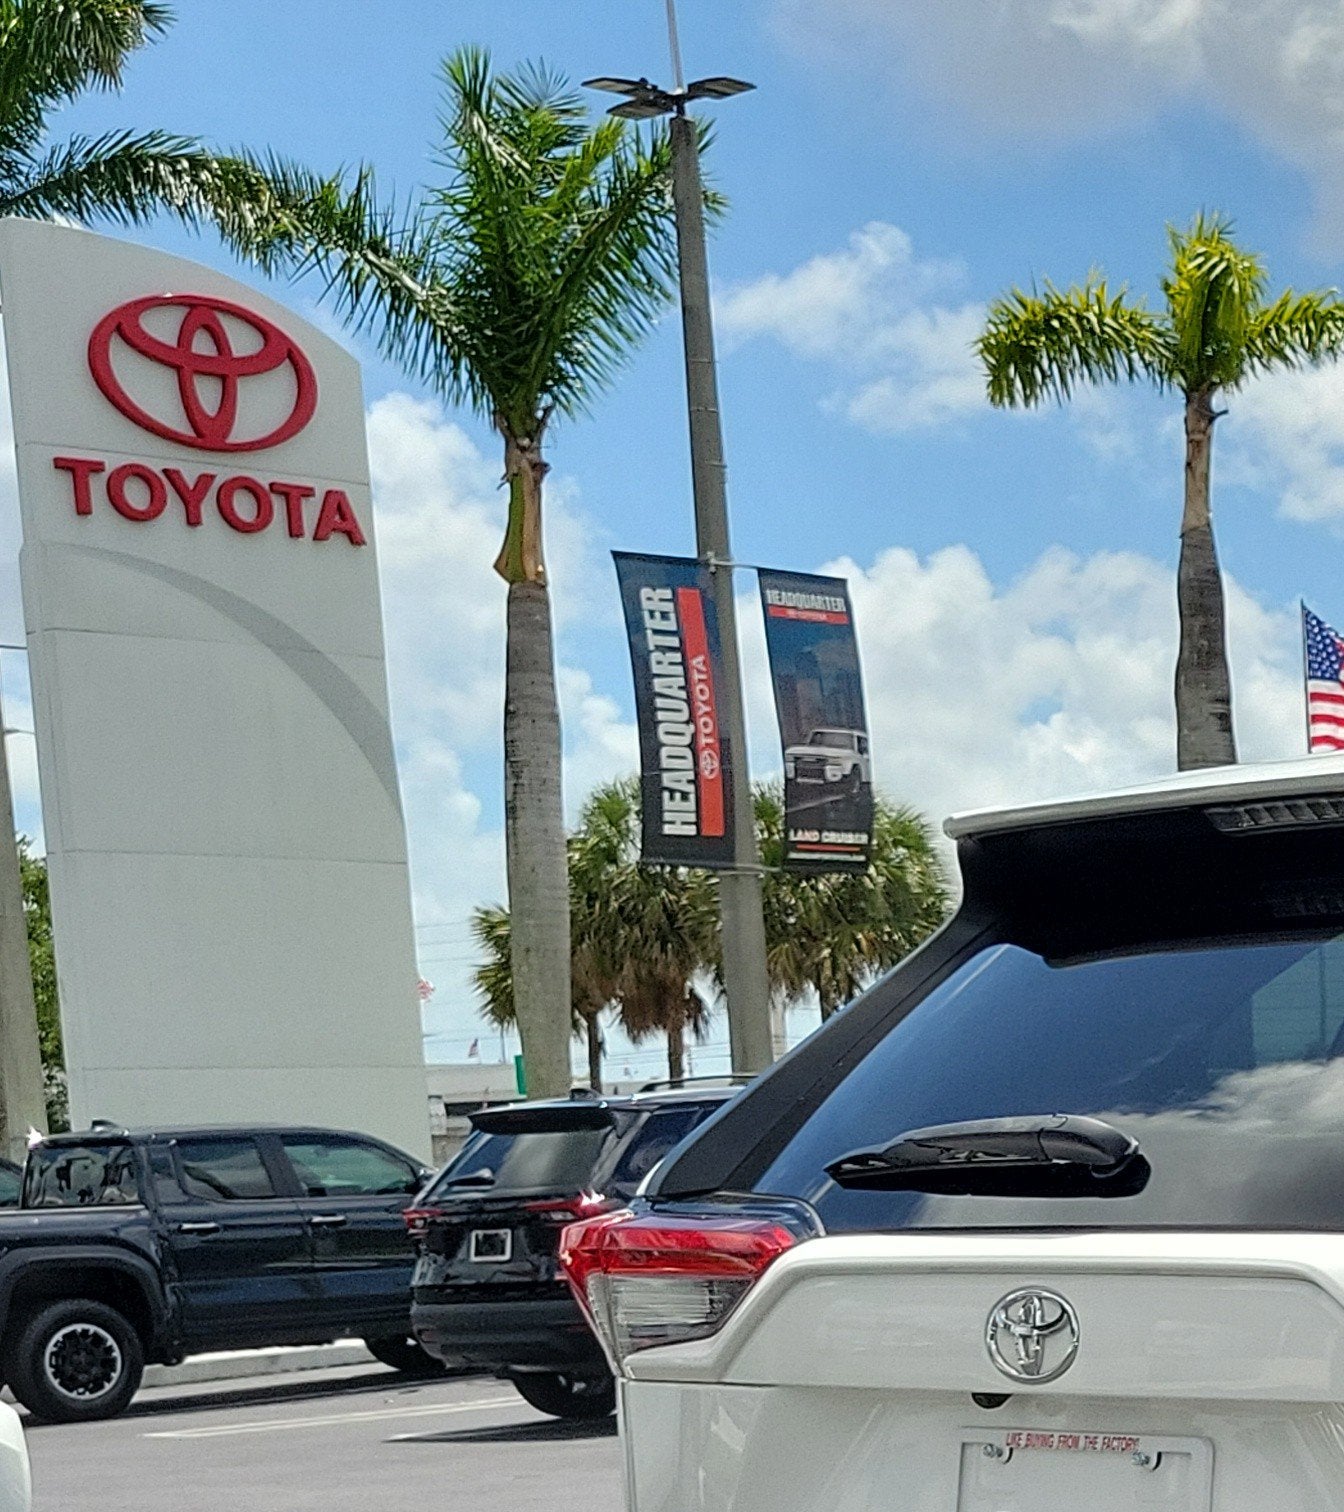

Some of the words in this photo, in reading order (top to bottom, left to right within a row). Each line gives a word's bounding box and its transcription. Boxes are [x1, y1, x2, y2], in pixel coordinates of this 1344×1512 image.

[53, 457, 366, 547] TOYOTA
[640, 586, 698, 836] HEADQUARTER
[690, 655, 715, 748] TOYOTA
[1006, 1432, 1023, 1447] LIKE
[1025, 1433, 1054, 1449] BUYING
[1057, 1435, 1080, 1449] FROM
[1084, 1436, 1099, 1450] THE
